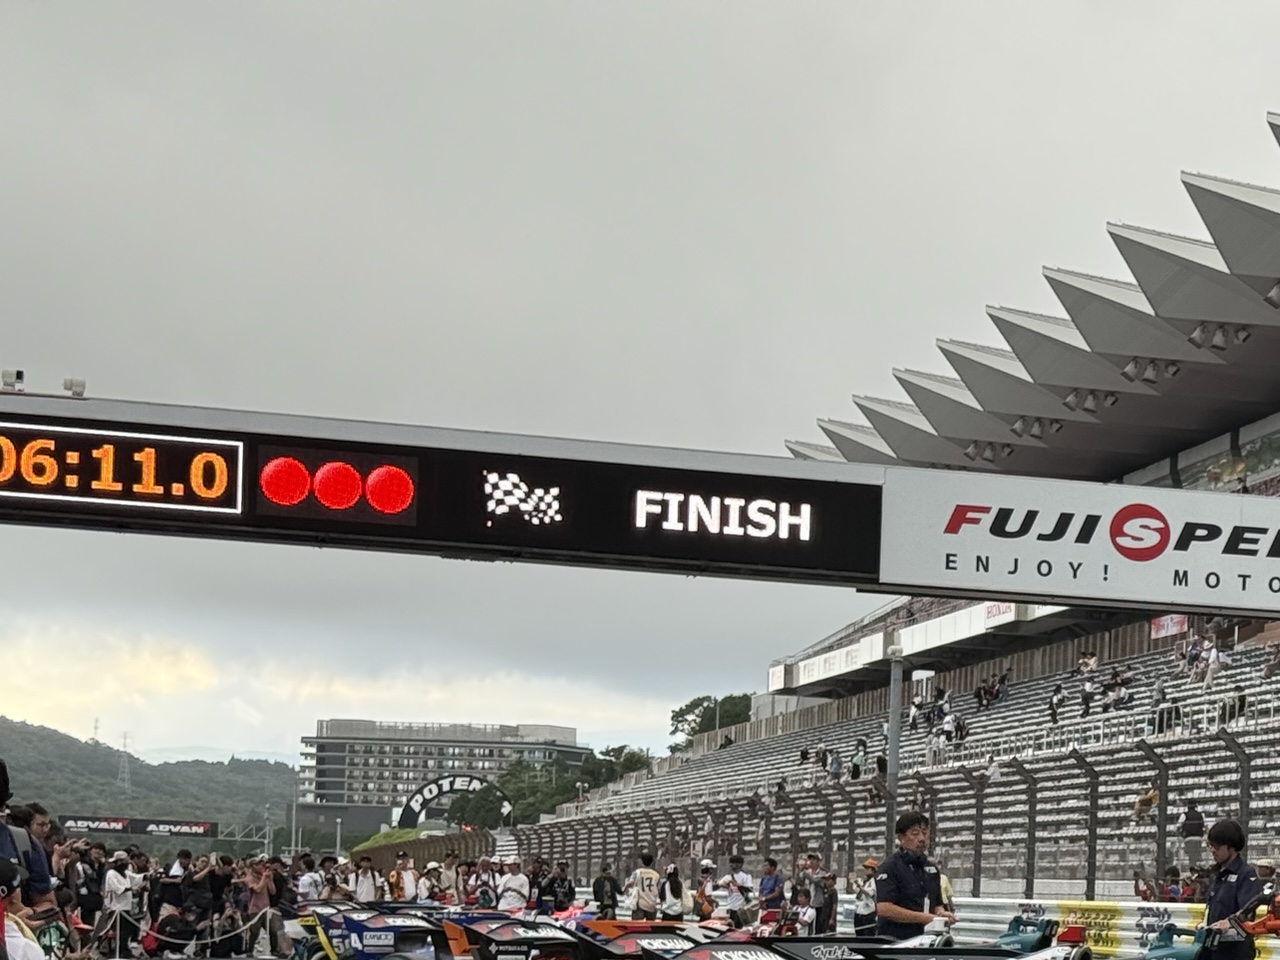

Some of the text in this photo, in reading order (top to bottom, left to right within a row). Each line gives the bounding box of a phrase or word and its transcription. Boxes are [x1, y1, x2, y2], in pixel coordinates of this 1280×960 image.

[635, 490, 811, 540] FINISH
[943, 504, 1102, 544] FUJI
[945, 553, 1109, 582] ENJOY!
[65, 819, 124, 831] ADVAN
[146, 823, 205, 835] ADVAN
[351, 933, 363, 951] 4
